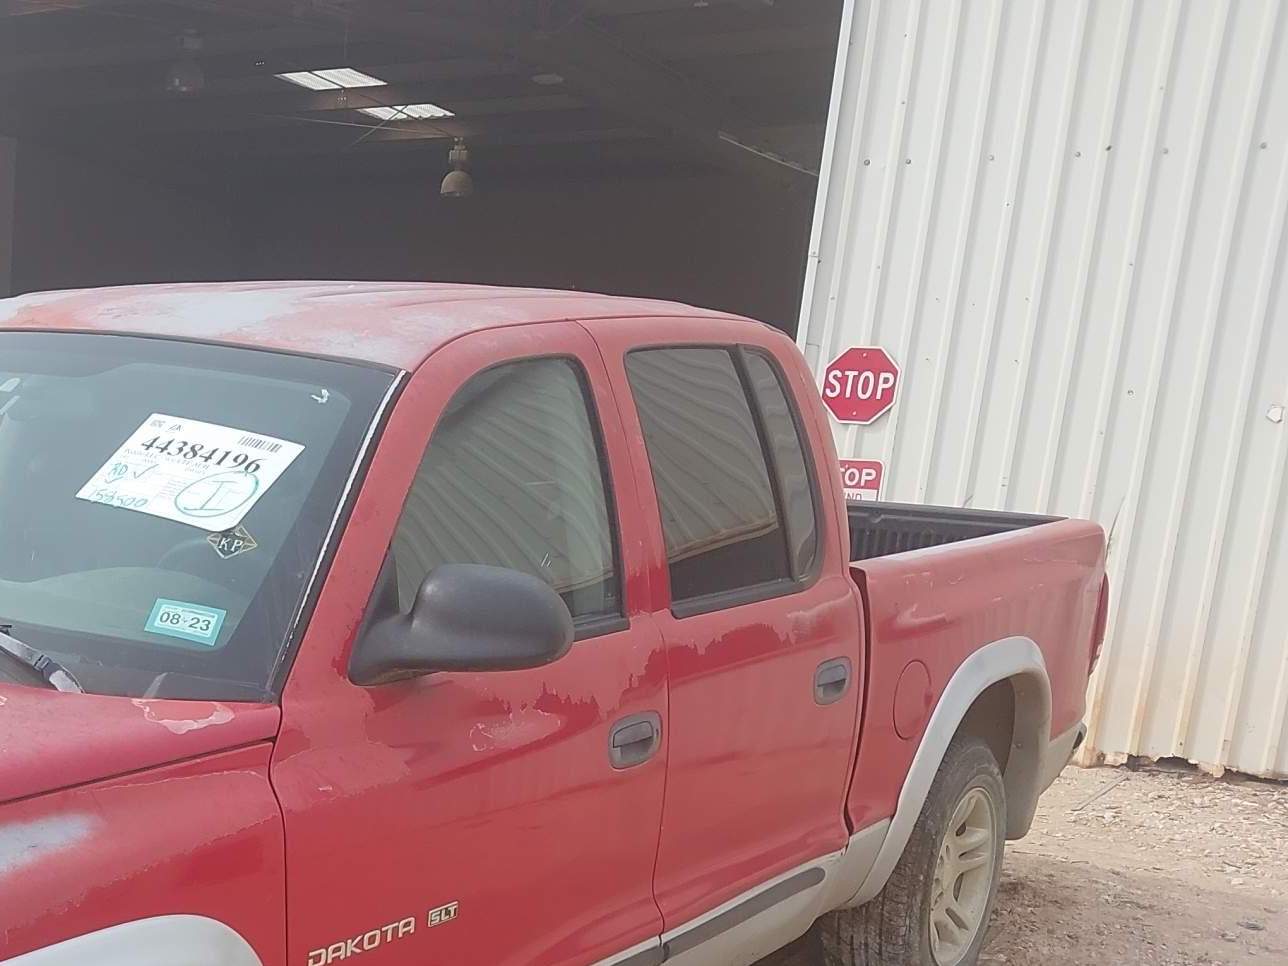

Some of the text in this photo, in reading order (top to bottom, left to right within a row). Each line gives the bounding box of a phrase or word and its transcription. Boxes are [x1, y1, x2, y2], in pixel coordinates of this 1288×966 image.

[825, 369, 895, 400] STOP
[140, 435, 263, 474] 44384196
[839, 467, 877, 486] OP
[429, 904, 458, 925] SLT
